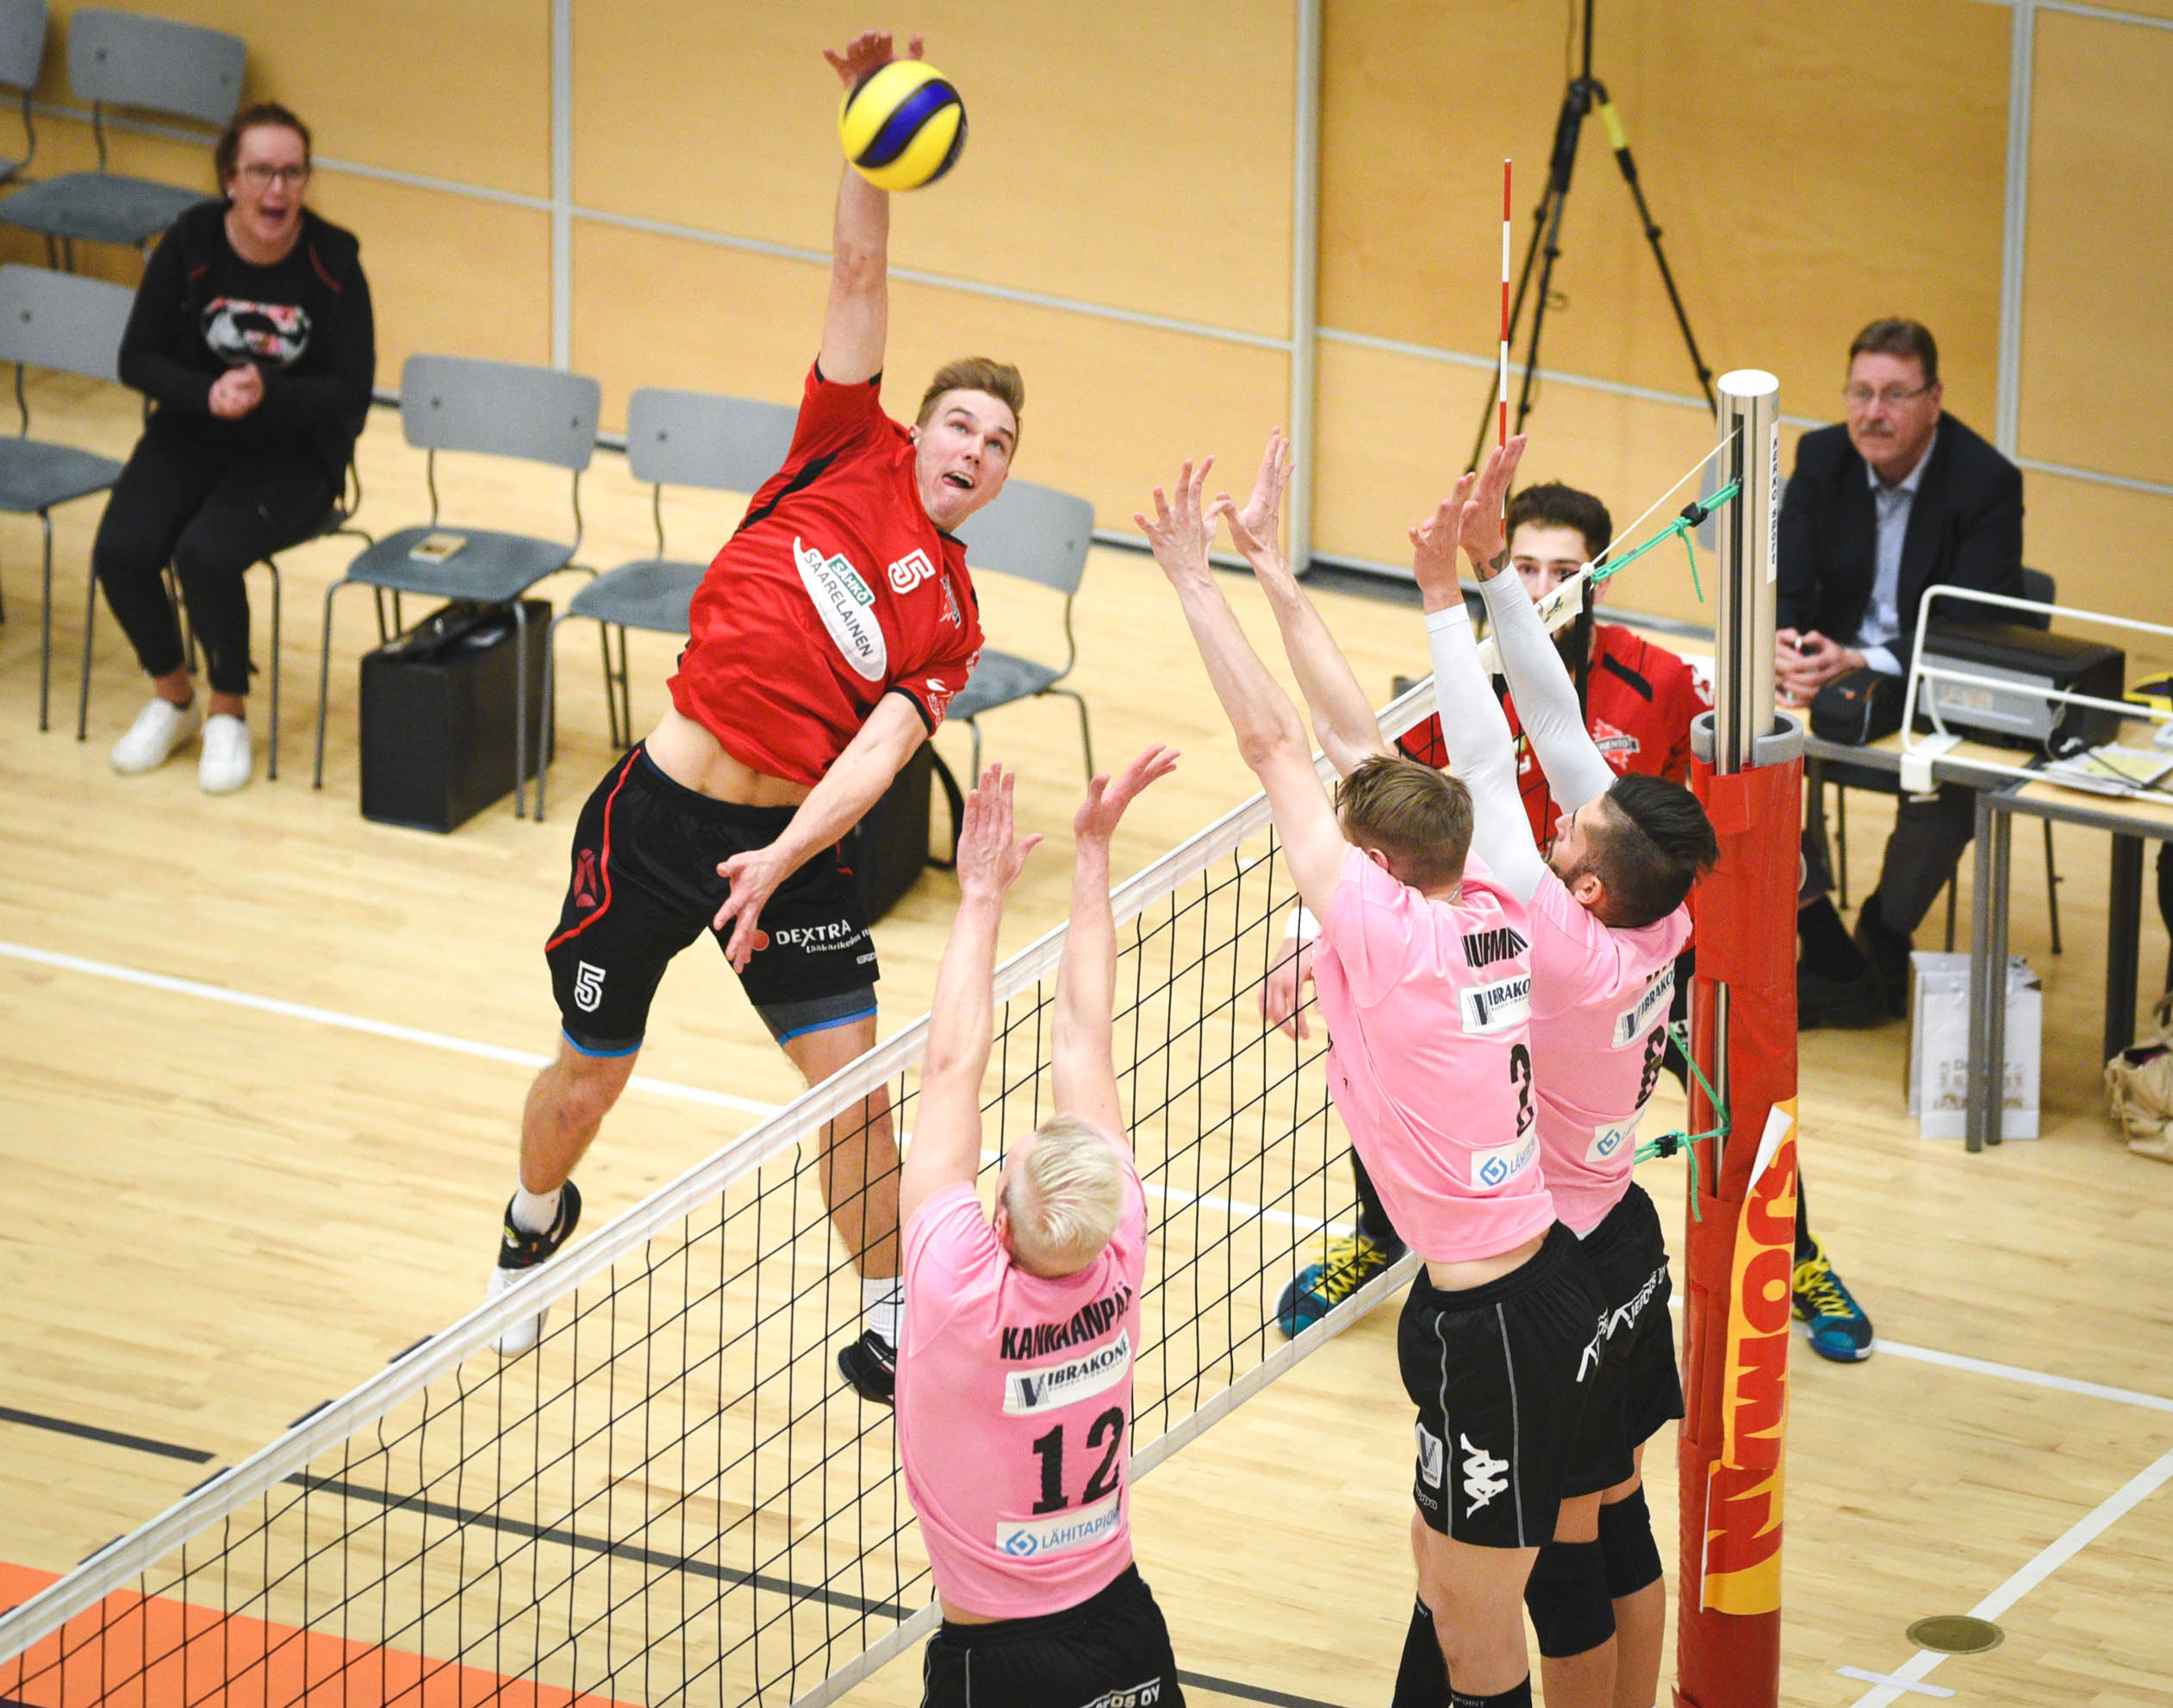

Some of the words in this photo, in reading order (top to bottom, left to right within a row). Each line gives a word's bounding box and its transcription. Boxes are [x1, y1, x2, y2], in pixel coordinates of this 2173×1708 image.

[804, 552, 874, 658] SAARELAINEN
[887, 546, 936, 594] 5
[775, 919, 851, 947] DEXTRA
[574, 960, 606, 1013] 5
[1510, 1044, 1532, 1138] 2
[1032, 1406, 1124, 1515] 12
